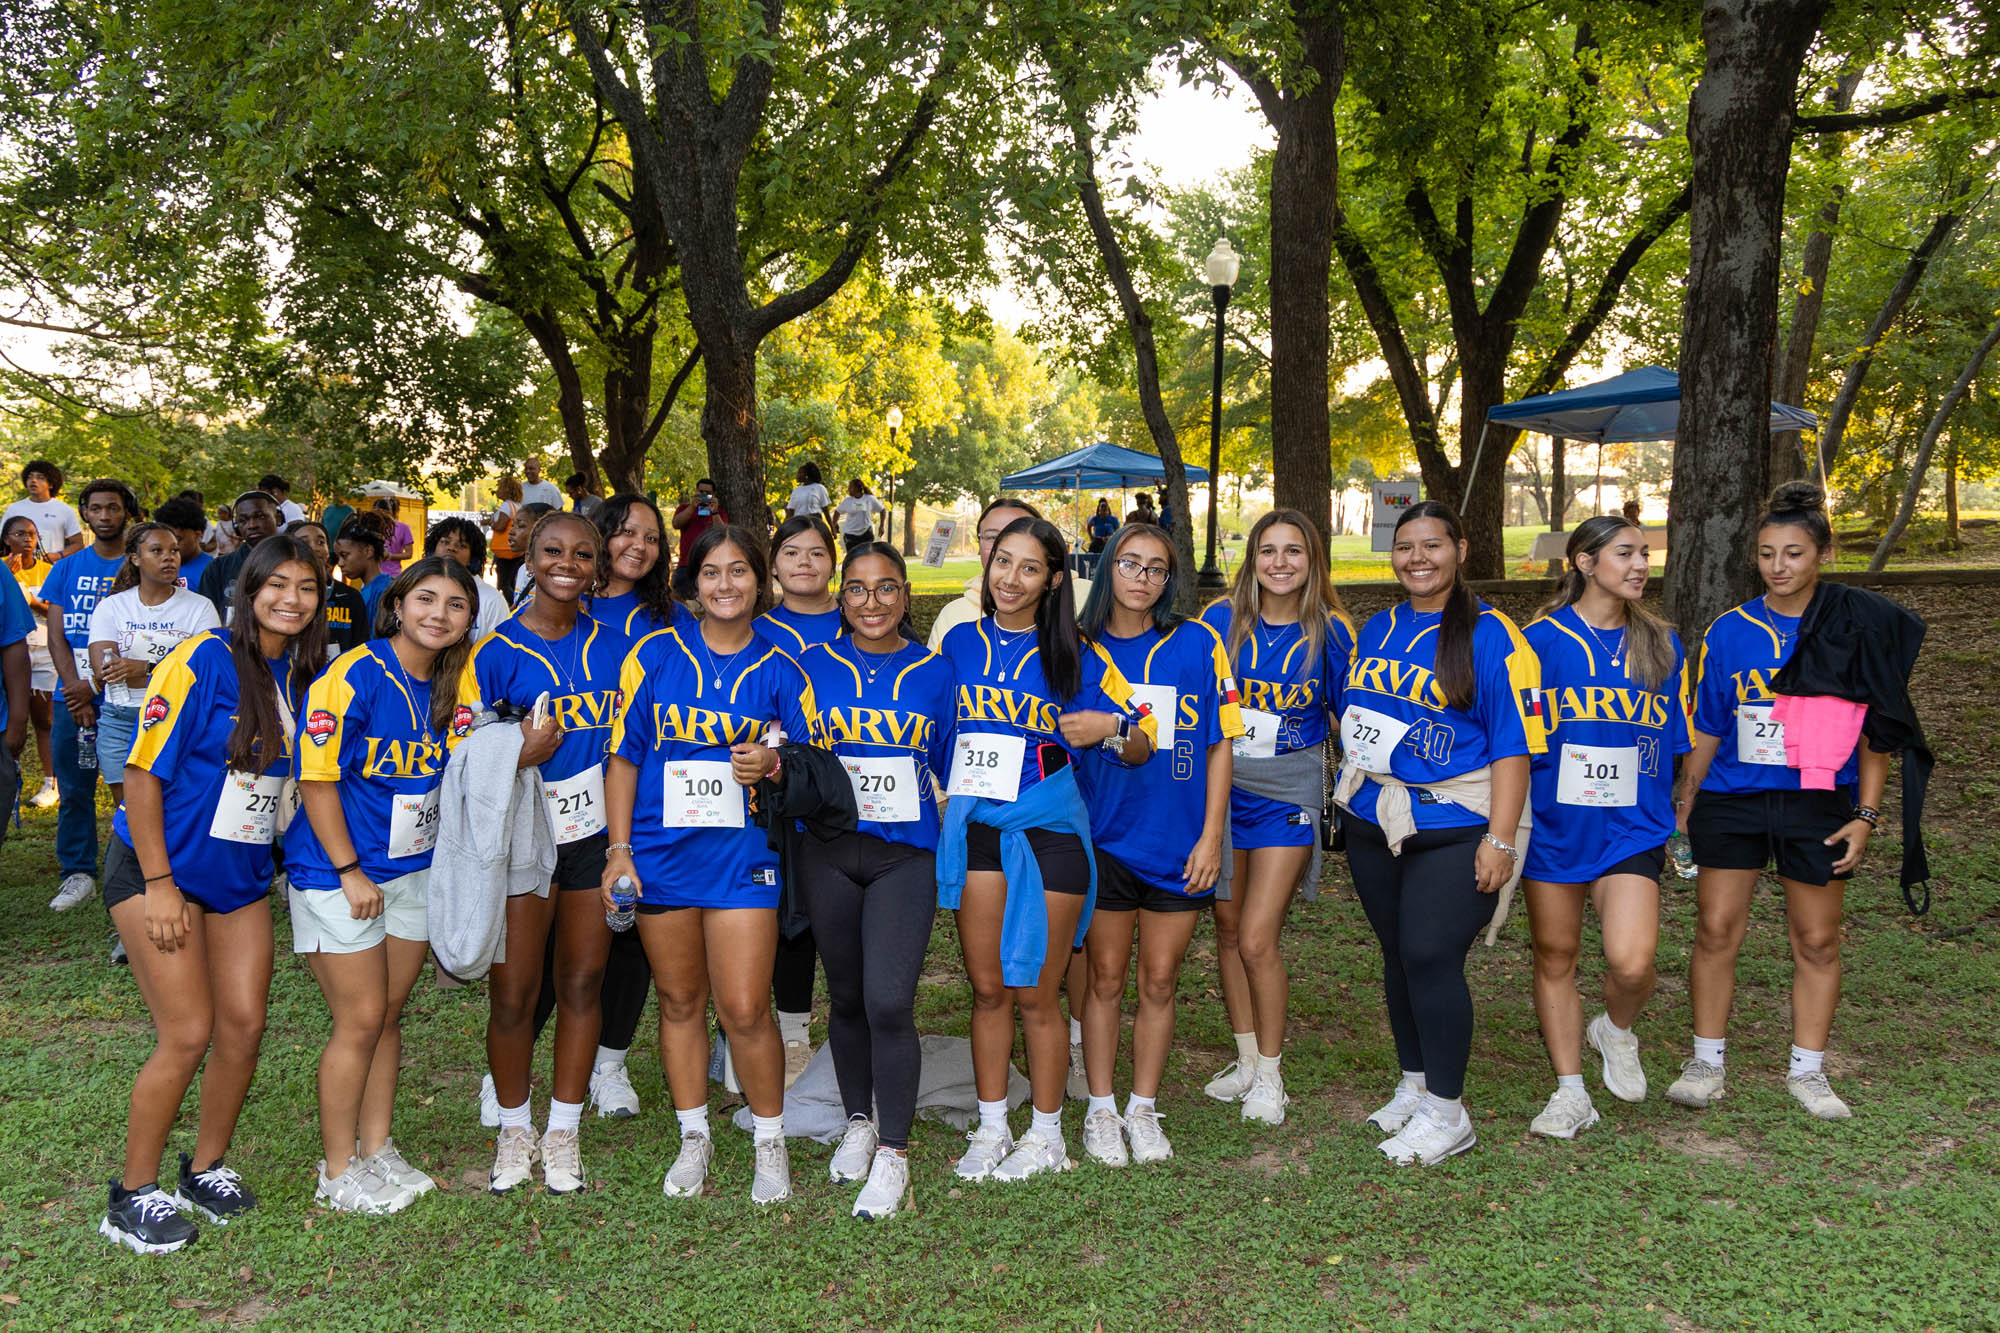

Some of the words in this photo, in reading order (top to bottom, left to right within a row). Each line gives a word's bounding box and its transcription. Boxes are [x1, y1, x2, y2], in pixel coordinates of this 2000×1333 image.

[126, 621, 146, 630] THIS
[148, 621, 158, 630] IS
[160, 621, 175, 630] MY
[327, 607, 352, 623] BALL
[147, 643, 174, 657] 28
[1240, 677, 1319, 710] RVIS
[552, 690, 617, 731] RVI
[956, 684, 1062, 732] ARVIS
[1541, 686, 1669, 736] JARVIS
[1352, 723, 1380, 745] 272
[1755, 722, 1785, 738] 27
[1403, 717, 1455, 766] 40
[965, 750, 999, 768] 318
[1584, 763, 1619, 780] 101
[685, 778, 723, 796] 100
[860, 775, 896, 792] 270
[245, 793, 278, 814] 275
[558, 789, 594, 815] 271
[415, 804, 439, 828] 269
